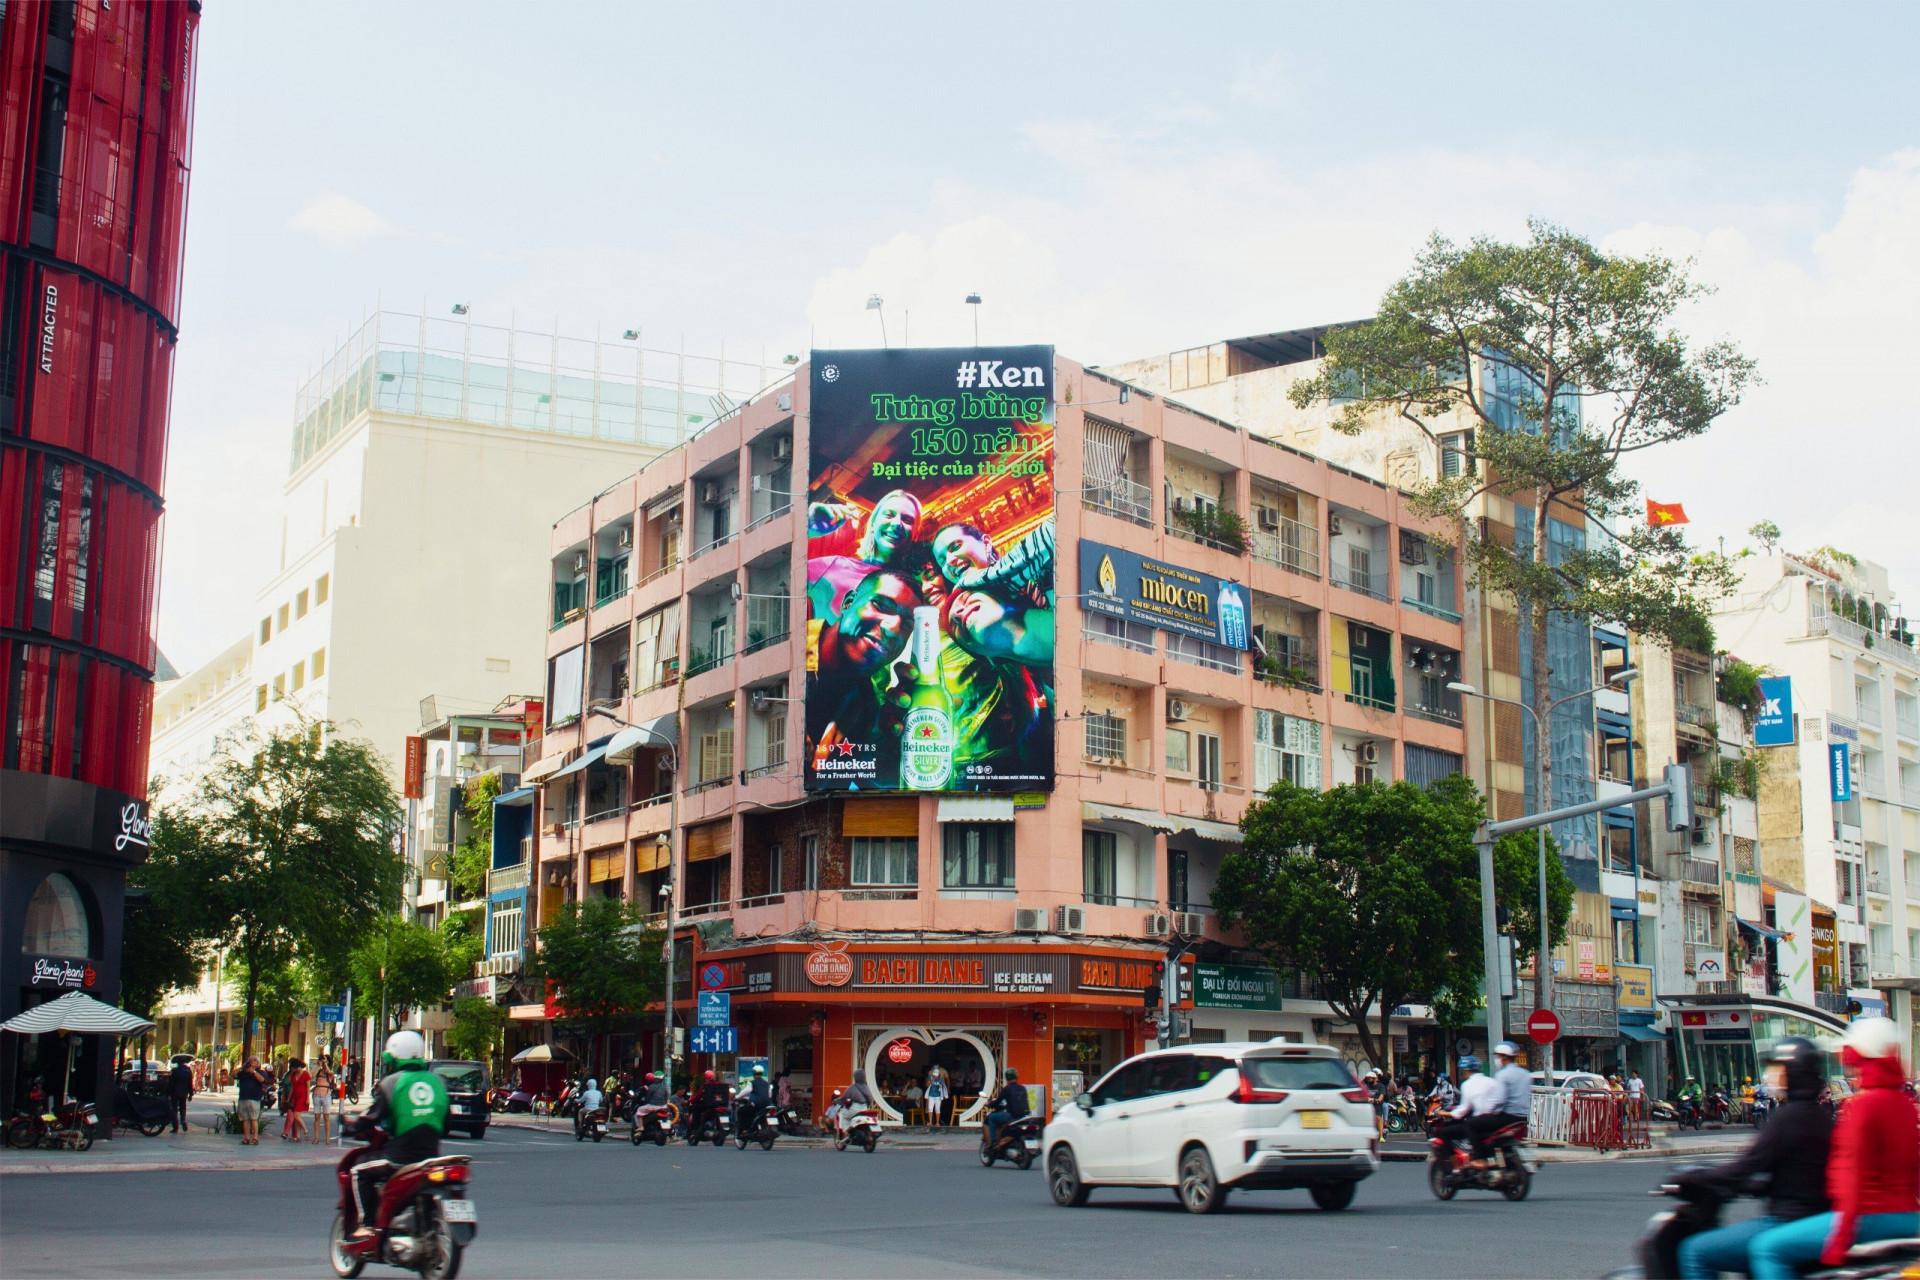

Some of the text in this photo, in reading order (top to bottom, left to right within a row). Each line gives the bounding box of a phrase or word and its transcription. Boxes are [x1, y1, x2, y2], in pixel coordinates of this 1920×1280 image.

[42, 285, 57, 374] ATTRACTED
[956, 360, 1045, 388] #Ken
[871, 390, 1046, 425] Tưng bừng
[911, 427, 1044, 455] 150 năm
[872, 461, 901, 480] Đại
[905, 460, 938, 480] tiệc
[942, 460, 973, 476] của
[1010, 459, 1044, 478] giới
[1140, 576, 1209, 615] miocen
[816, 743, 877, 752] 150 YRS
[903, 741, 950, 752] Heineken
[816, 758, 876, 770] Heineken
[1834, 749, 1845, 796] EXIMBANK
[32, 959, 84, 986] Gloria Jean's
[862, 959, 983, 984] BACH DANG
[994, 972, 1053, 984] ICE CREAM
[1082, 960, 1116, 986] BACH
[1119, 963, 1153, 989] DANG
[1019, 985, 1045, 993] Coffee
[1203, 977, 1216, 992] ĐẠI
[1217, 976, 1225, 990] LÝ
[1242, 980, 1264, 994] NGOẠI
